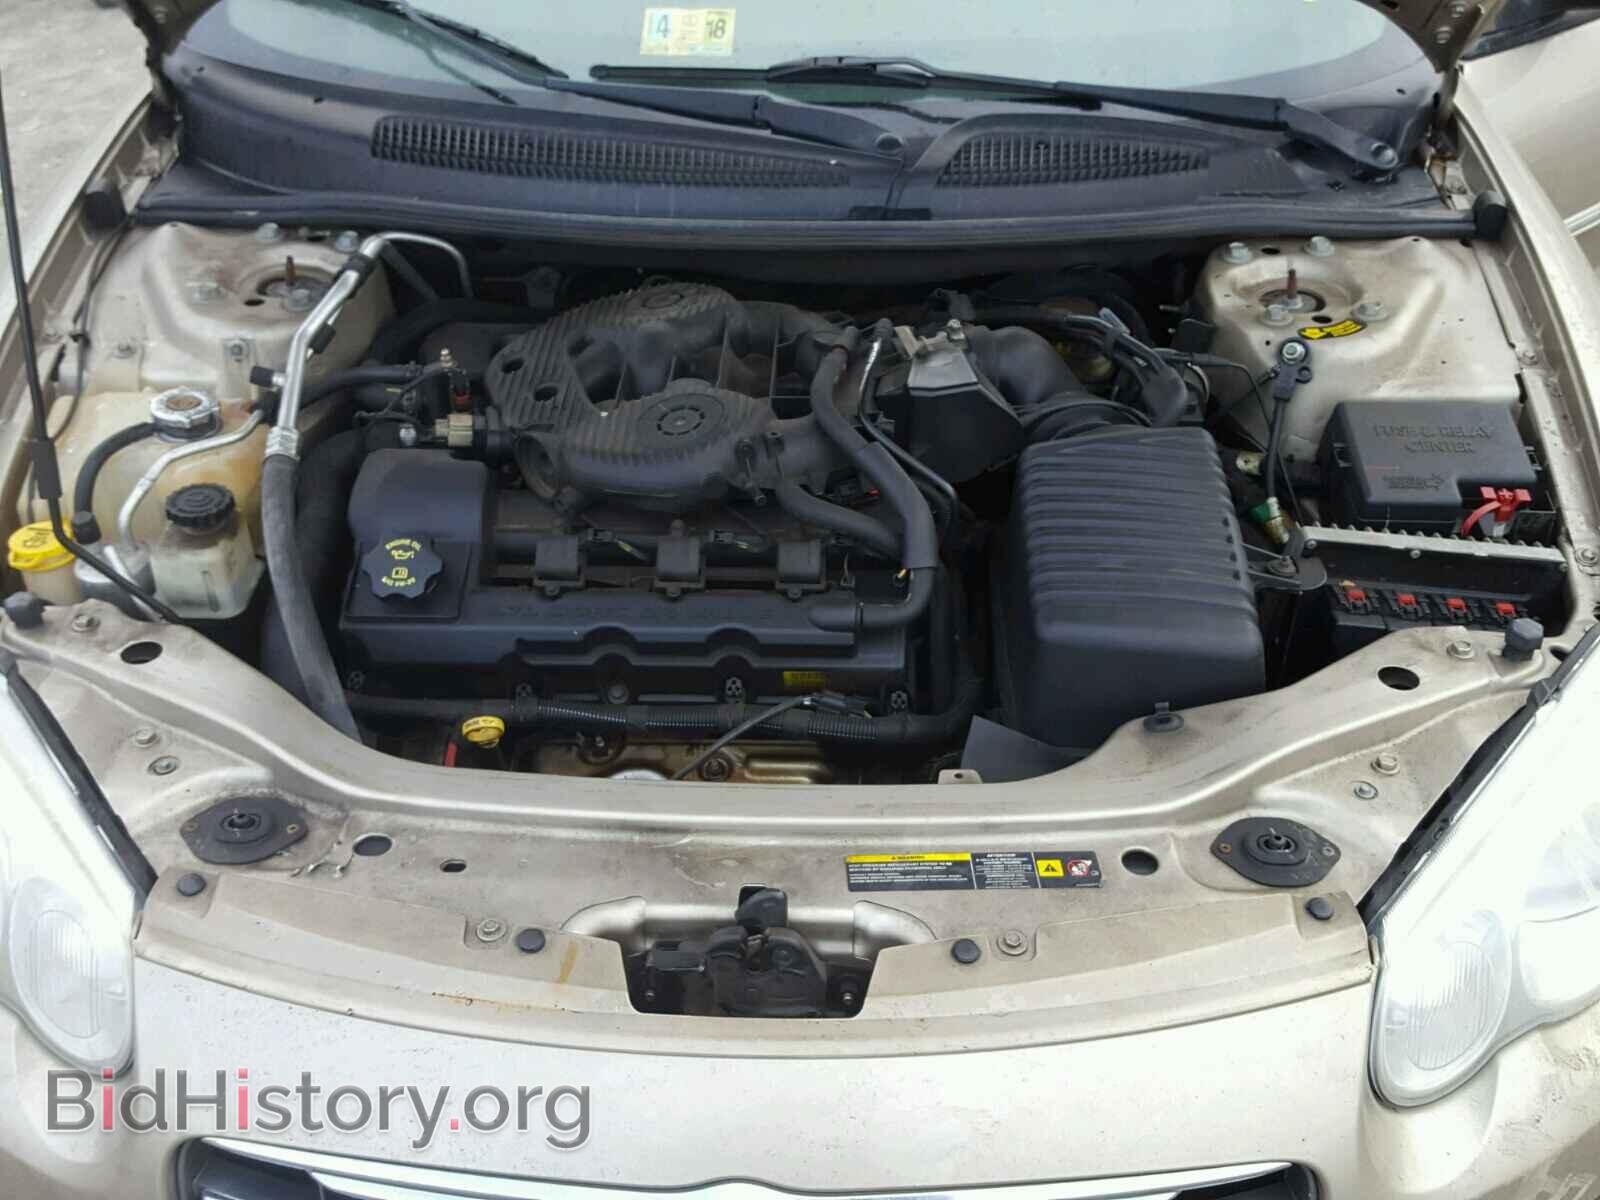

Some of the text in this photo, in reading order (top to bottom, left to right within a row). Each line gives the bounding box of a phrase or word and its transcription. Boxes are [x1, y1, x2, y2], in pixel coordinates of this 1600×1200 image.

[655, 14, 670, 39] 4
[706, 18, 727, 40] 18
[1439, 424, 1495, 440] RELAY
[1404, 438, 1475, 454] CENTER
